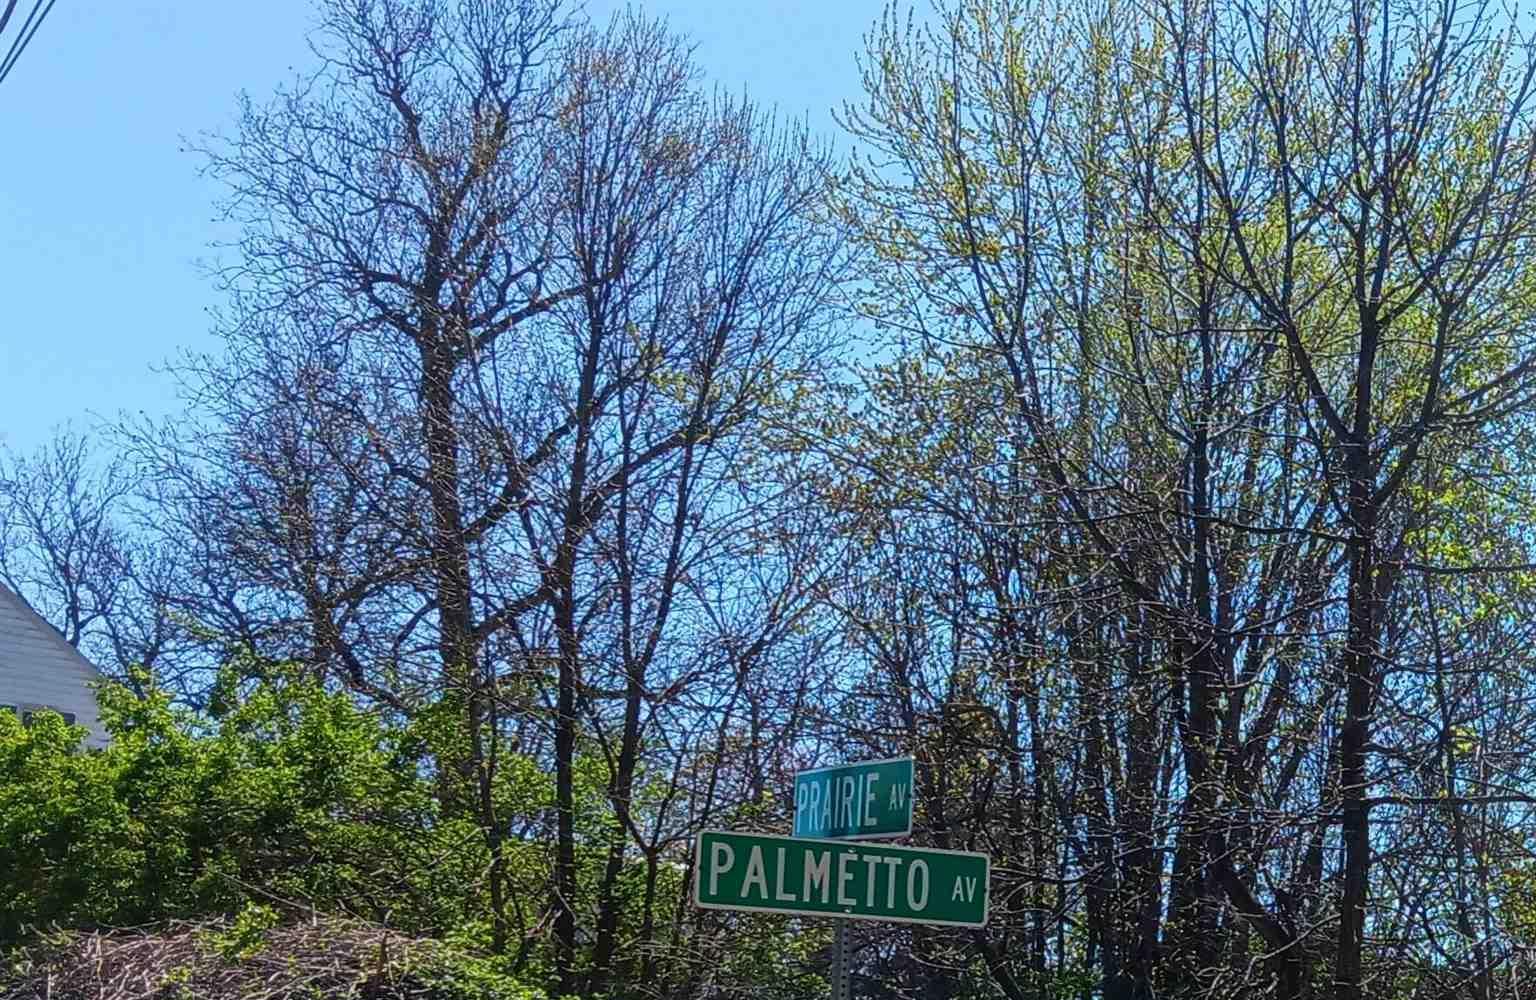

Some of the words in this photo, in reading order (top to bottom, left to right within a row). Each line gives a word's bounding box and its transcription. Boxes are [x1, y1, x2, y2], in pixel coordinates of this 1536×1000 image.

[796, 772, 880, 833] PRAIRIE
[888, 783, 906, 811] AV
[709, 841, 930, 911] PALMETTO
[952, 877, 977, 902] AV
